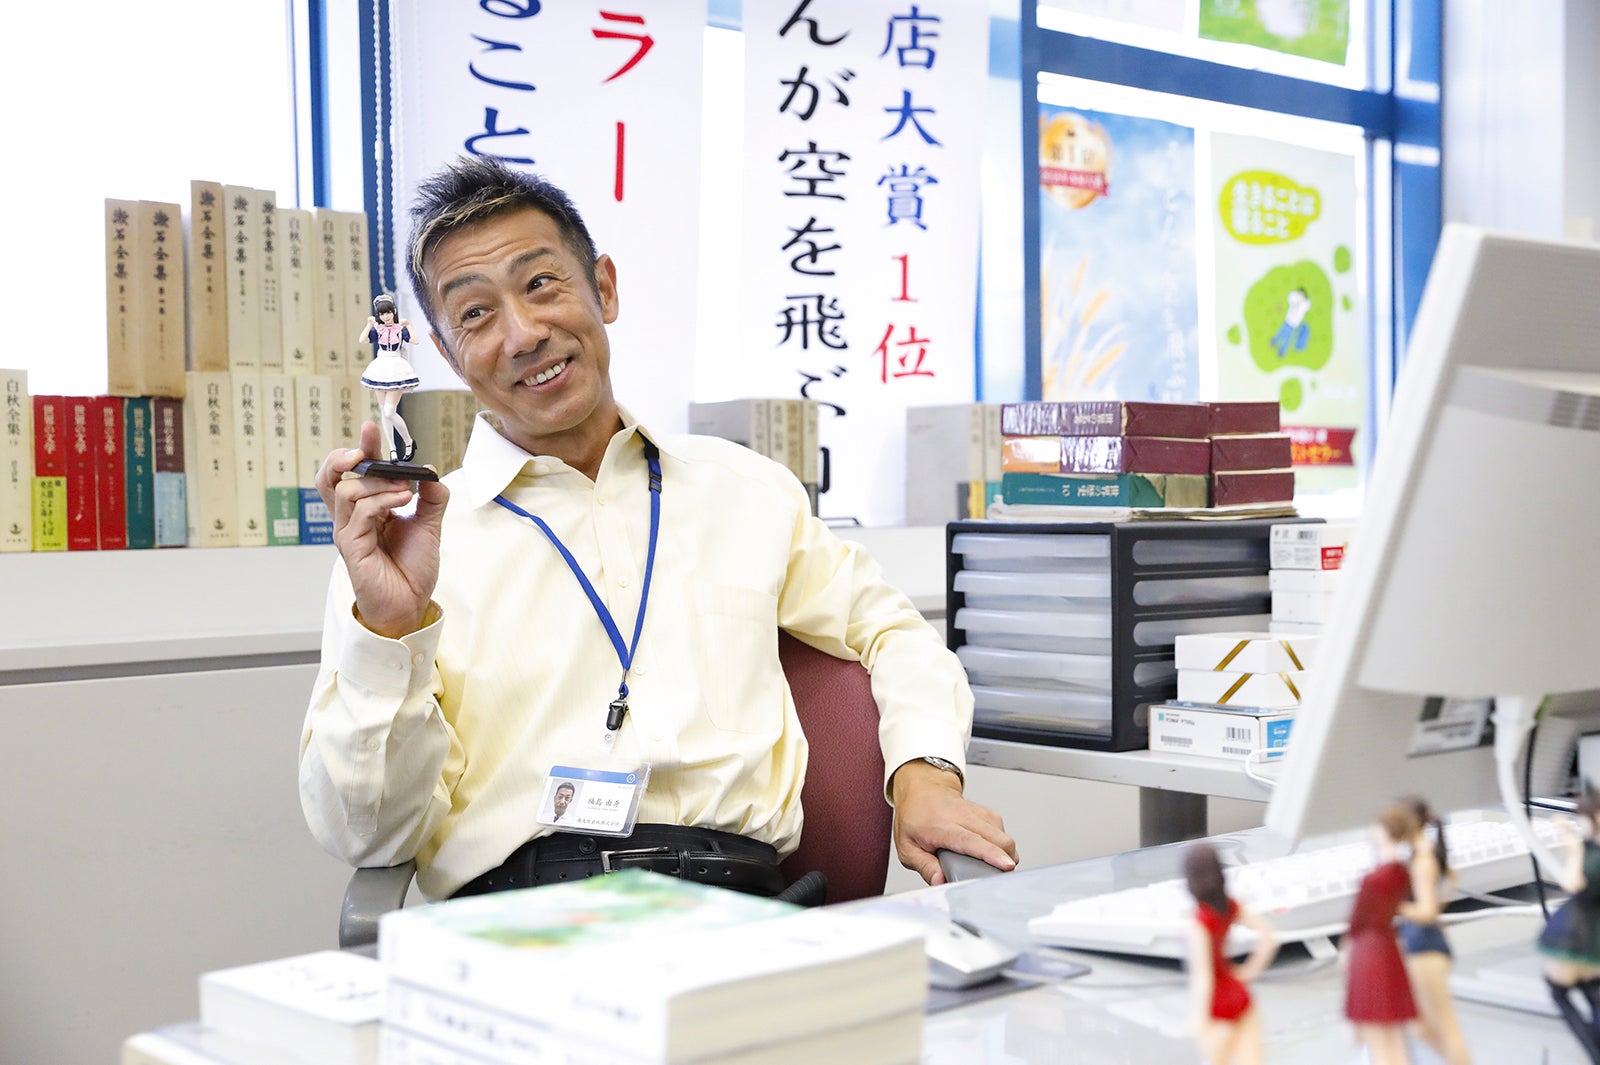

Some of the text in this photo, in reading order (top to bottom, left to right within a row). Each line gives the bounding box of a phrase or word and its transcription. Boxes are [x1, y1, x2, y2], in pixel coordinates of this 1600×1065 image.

[591, 10, 655, 202] ラー
[111, 207, 129, 280] 漱石全集
[152, 209, 170, 281] 漱石全集
[199, 188, 216, 260] 漱石全集
[232, 194, 249, 264] 漱石全集
[262, 200, 276, 254] 漱石全集
[288, 216, 302, 269] 白秋全集
[322, 218, 335, 272] 白秋全集
[349, 220, 363, 272] 白秋全集
[776, 0, 856, 494] んが空を飛ぶ
[6, 378, 21, 437] 白秋全集
[43, 404, 56, 455] 世界の文学
[74, 404, 87, 455] 世界の文学
[103, 406, 116, 456] 世界の文学
[206, 381, 221, 437] 白秋全集
[240, 382, 255, 437] 白秋全集
[273, 385, 286, 439] 白秋全集
[308, 385, 321, 437] 白秋全集
[340, 386, 352, 438] 白秋全集
